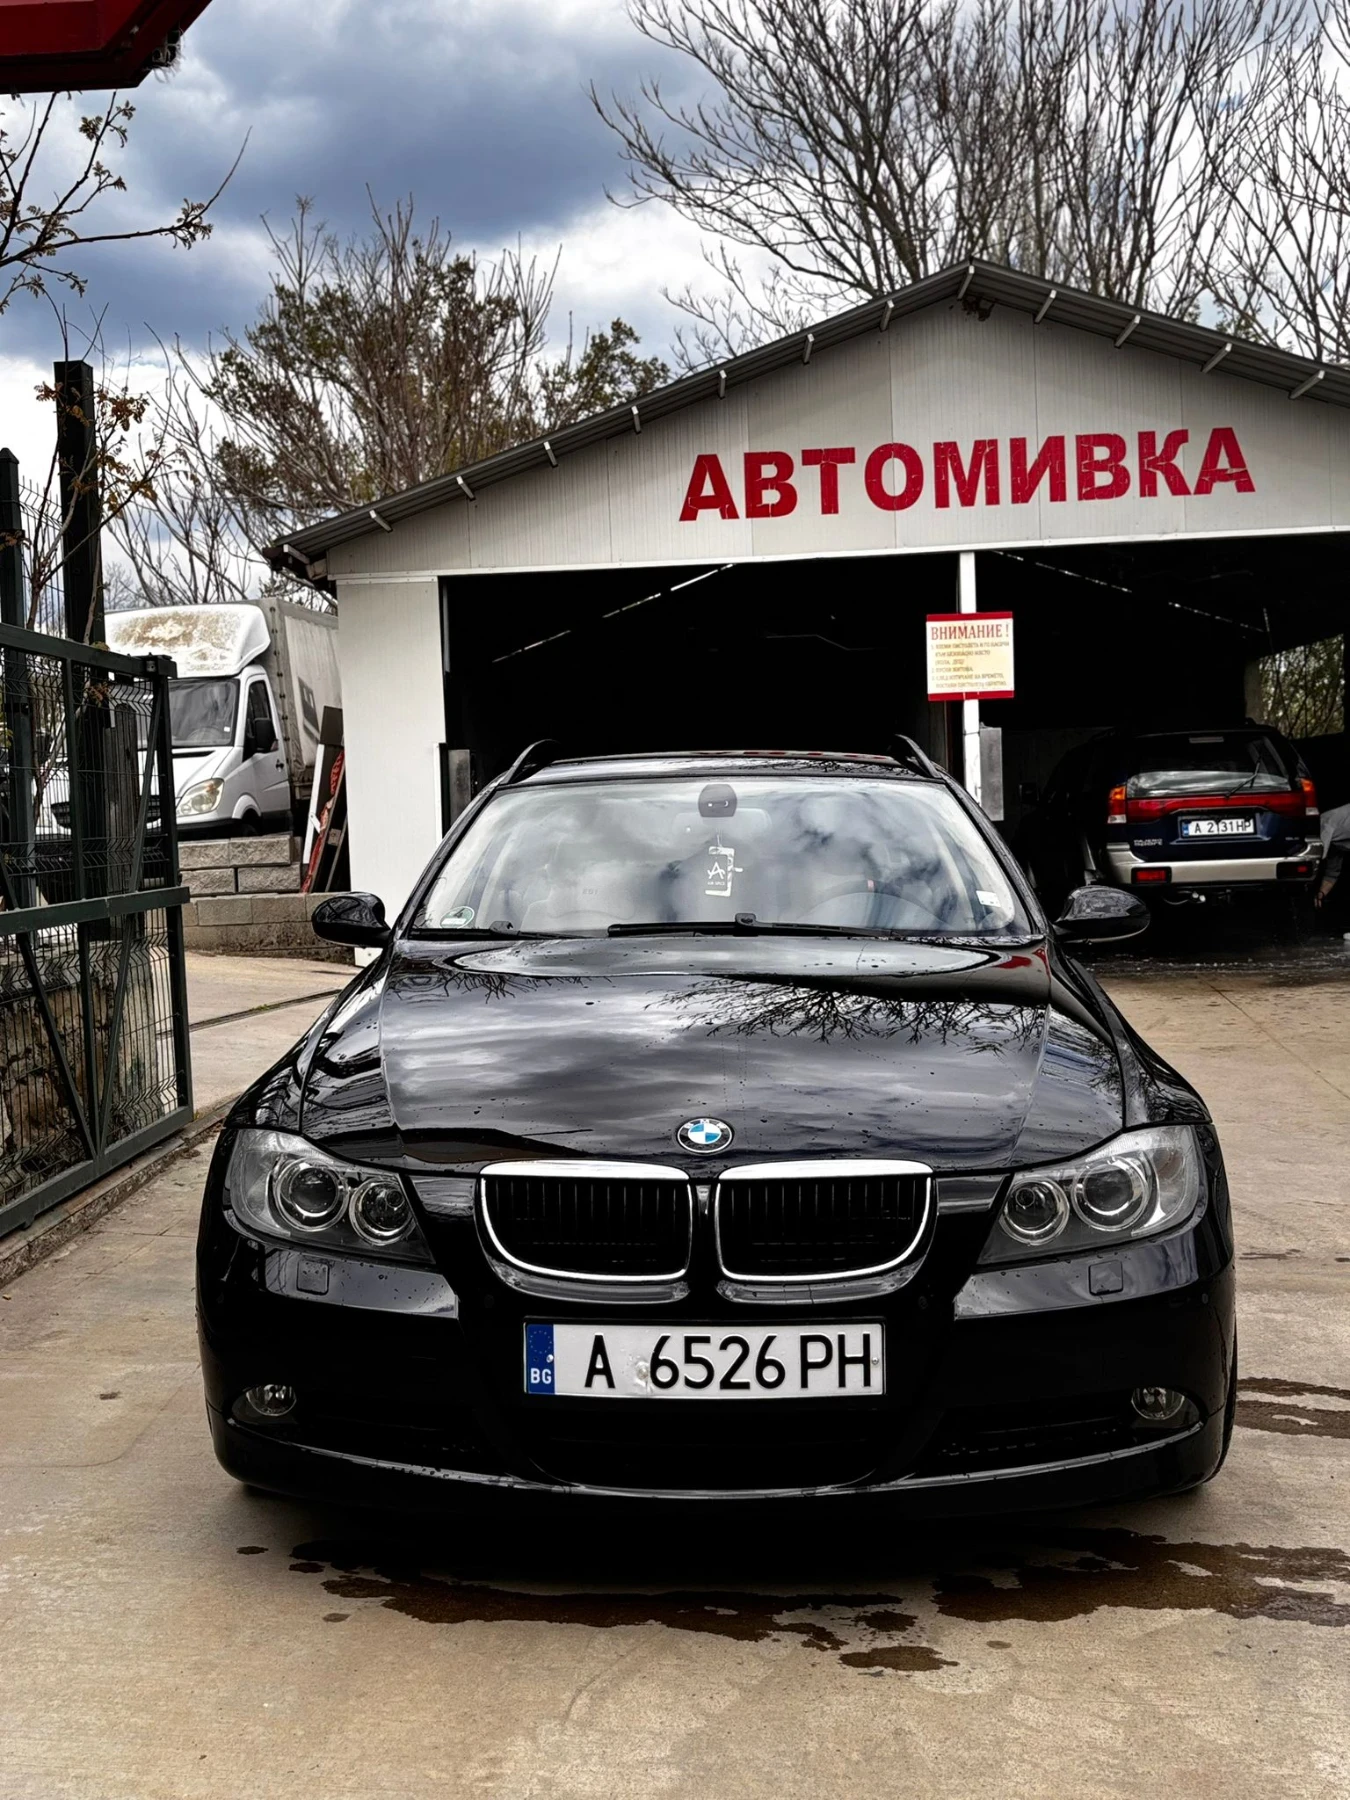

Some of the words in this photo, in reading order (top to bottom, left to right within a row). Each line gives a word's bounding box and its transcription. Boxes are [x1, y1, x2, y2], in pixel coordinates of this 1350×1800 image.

[679, 427, 1256, 522] АВТОМИВКА
[530, 1367, 552, 1385] BG
[584, 1333, 616, 1389] A
[650, 1333, 786, 1390] 6526
[799, 1333, 872, 1389] PH
